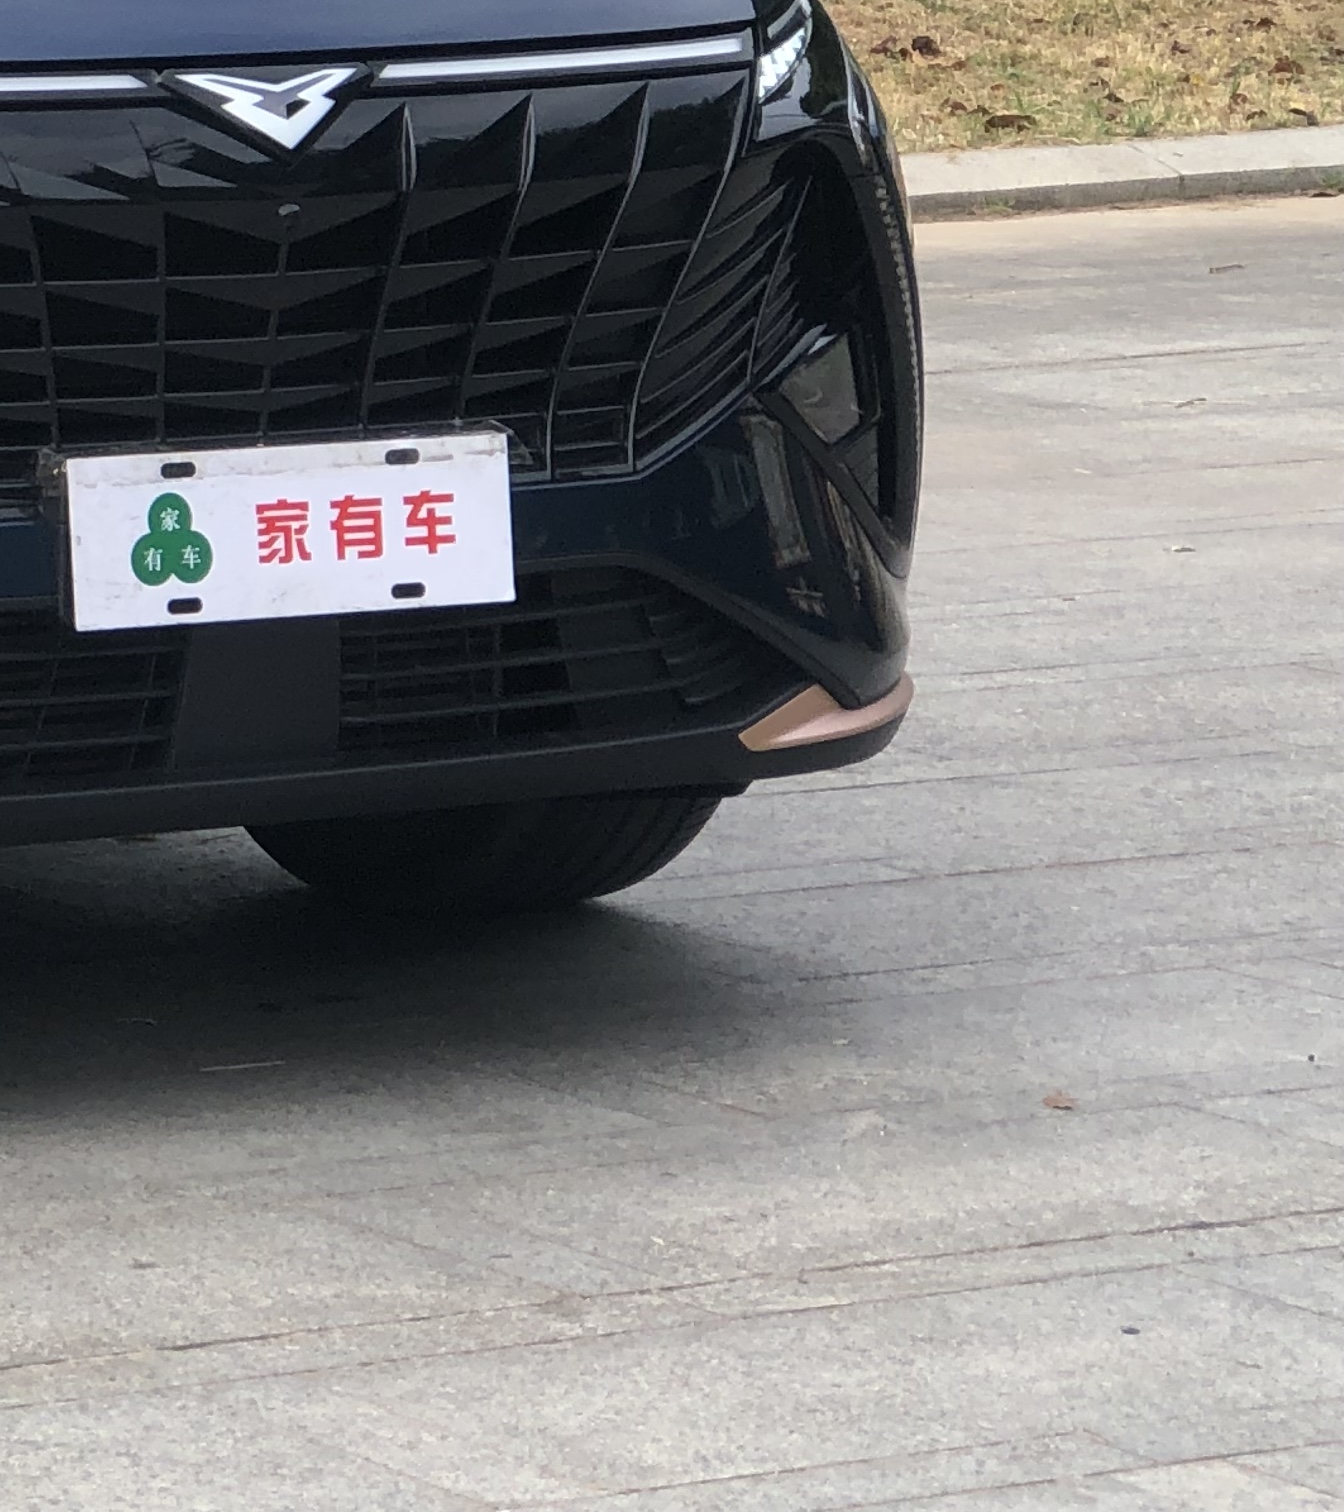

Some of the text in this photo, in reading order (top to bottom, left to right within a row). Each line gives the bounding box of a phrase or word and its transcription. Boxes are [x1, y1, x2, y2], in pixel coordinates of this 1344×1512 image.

[160, 507, 181, 532] 家
[256, 490, 456, 565] 家有车
